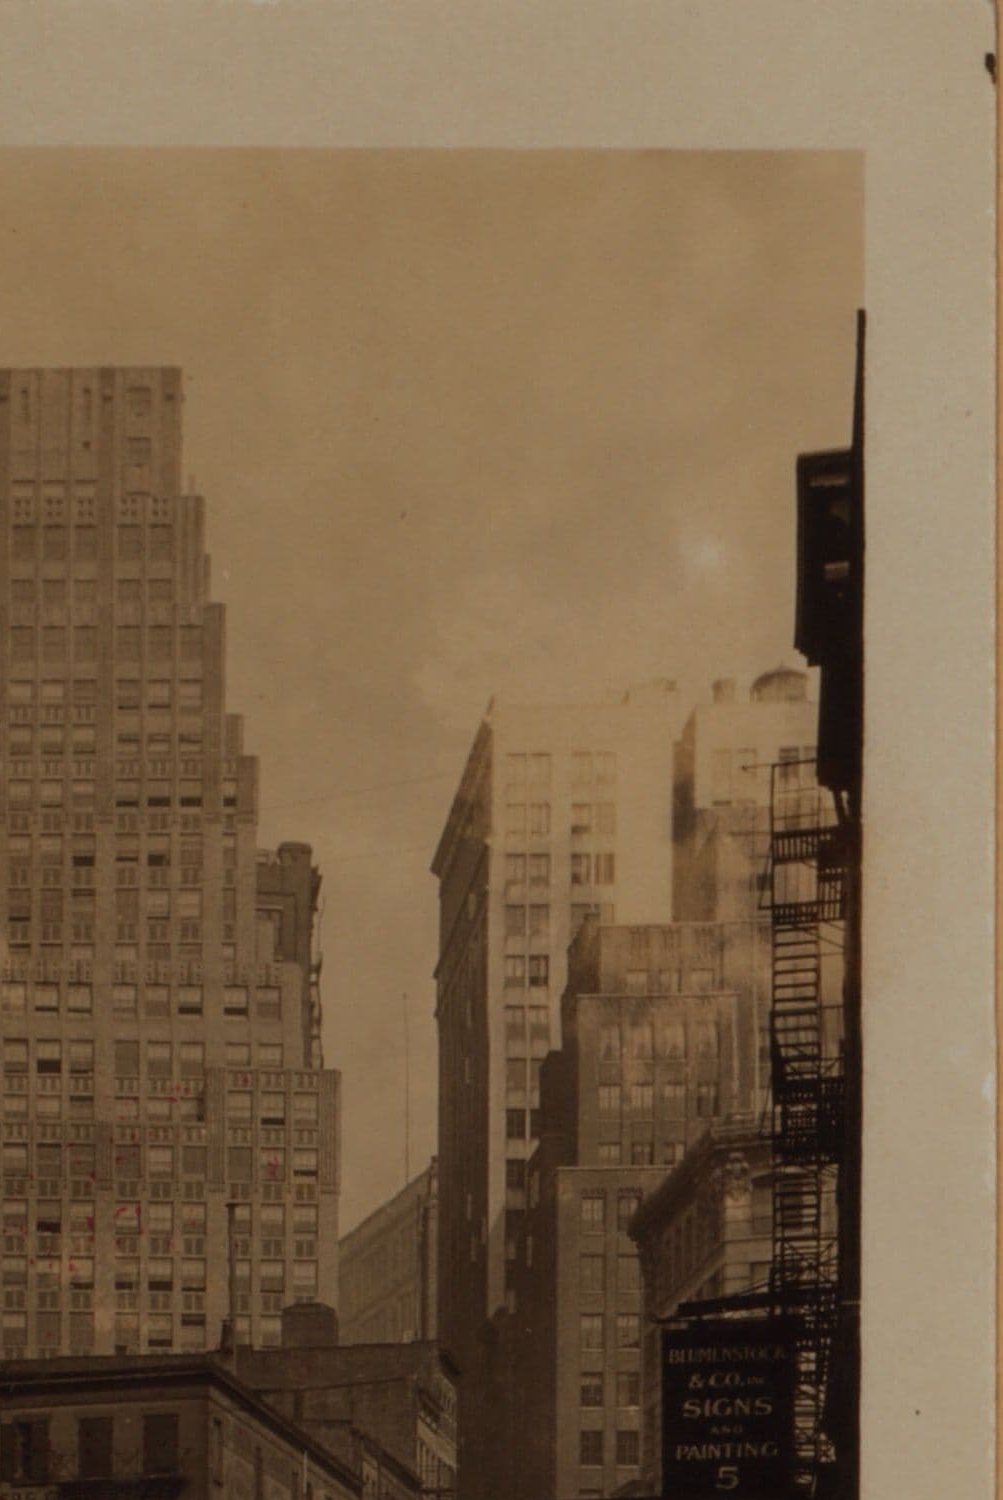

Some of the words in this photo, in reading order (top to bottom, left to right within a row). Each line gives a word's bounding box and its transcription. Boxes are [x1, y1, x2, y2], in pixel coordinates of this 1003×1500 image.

[688, 1372, 704, 1390] &
[682, 1396, 773, 1418] SIGNS
[710, 1424, 743, 1433] AND
[675, 1441, 778, 1460] PAINTING
[714, 1465, 739, 1490] 5
